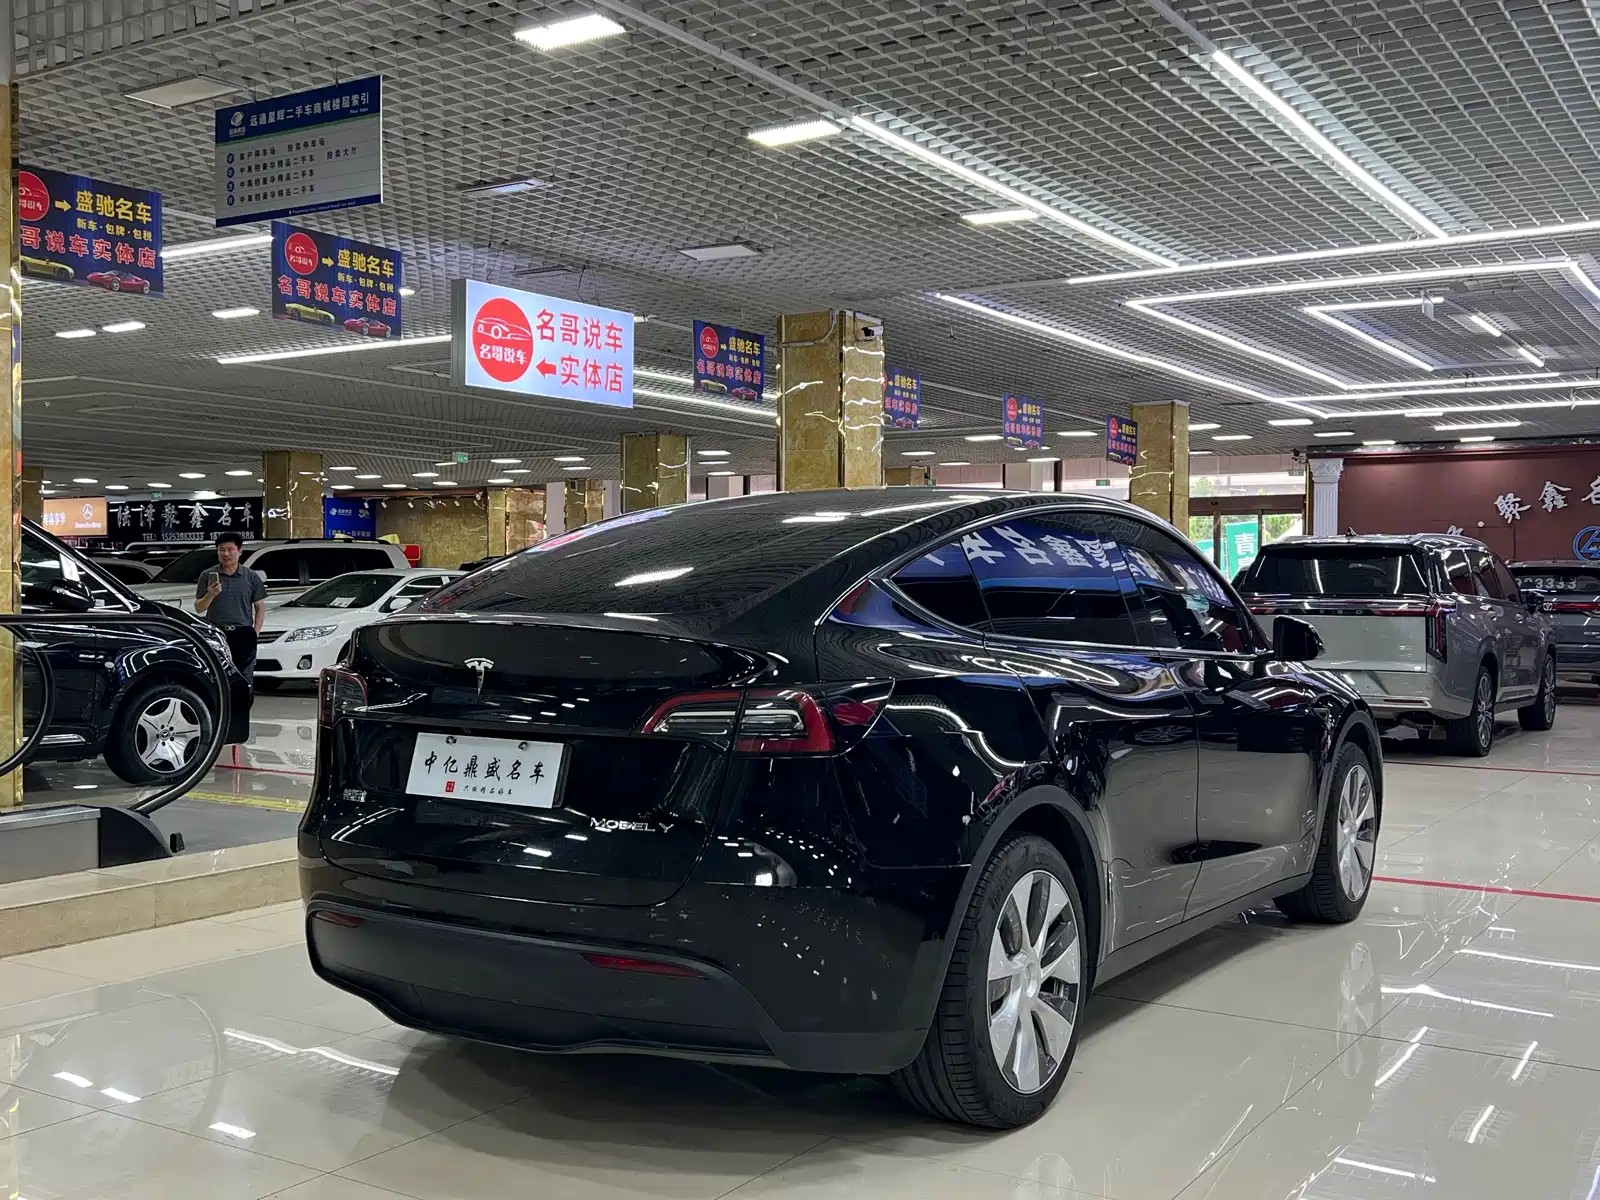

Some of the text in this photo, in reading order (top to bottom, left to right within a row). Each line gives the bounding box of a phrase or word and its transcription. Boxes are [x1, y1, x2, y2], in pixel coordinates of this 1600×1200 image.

[76, 190, 152, 224] 盛驰名车
[21, 226, 156, 269] 哥说车实体店
[338, 249, 395, 278] 盛驰名车
[278, 274, 396, 317] 名哥说车实体店
[536, 308, 624, 354] 名哥说车
[479, 344, 527, 365] 名哥说车
[560, 354, 624, 393] 实体店
[424, 751, 545, 785] 中亿鼎盛名车
[590, 817, 674, 834] MODEL Y
